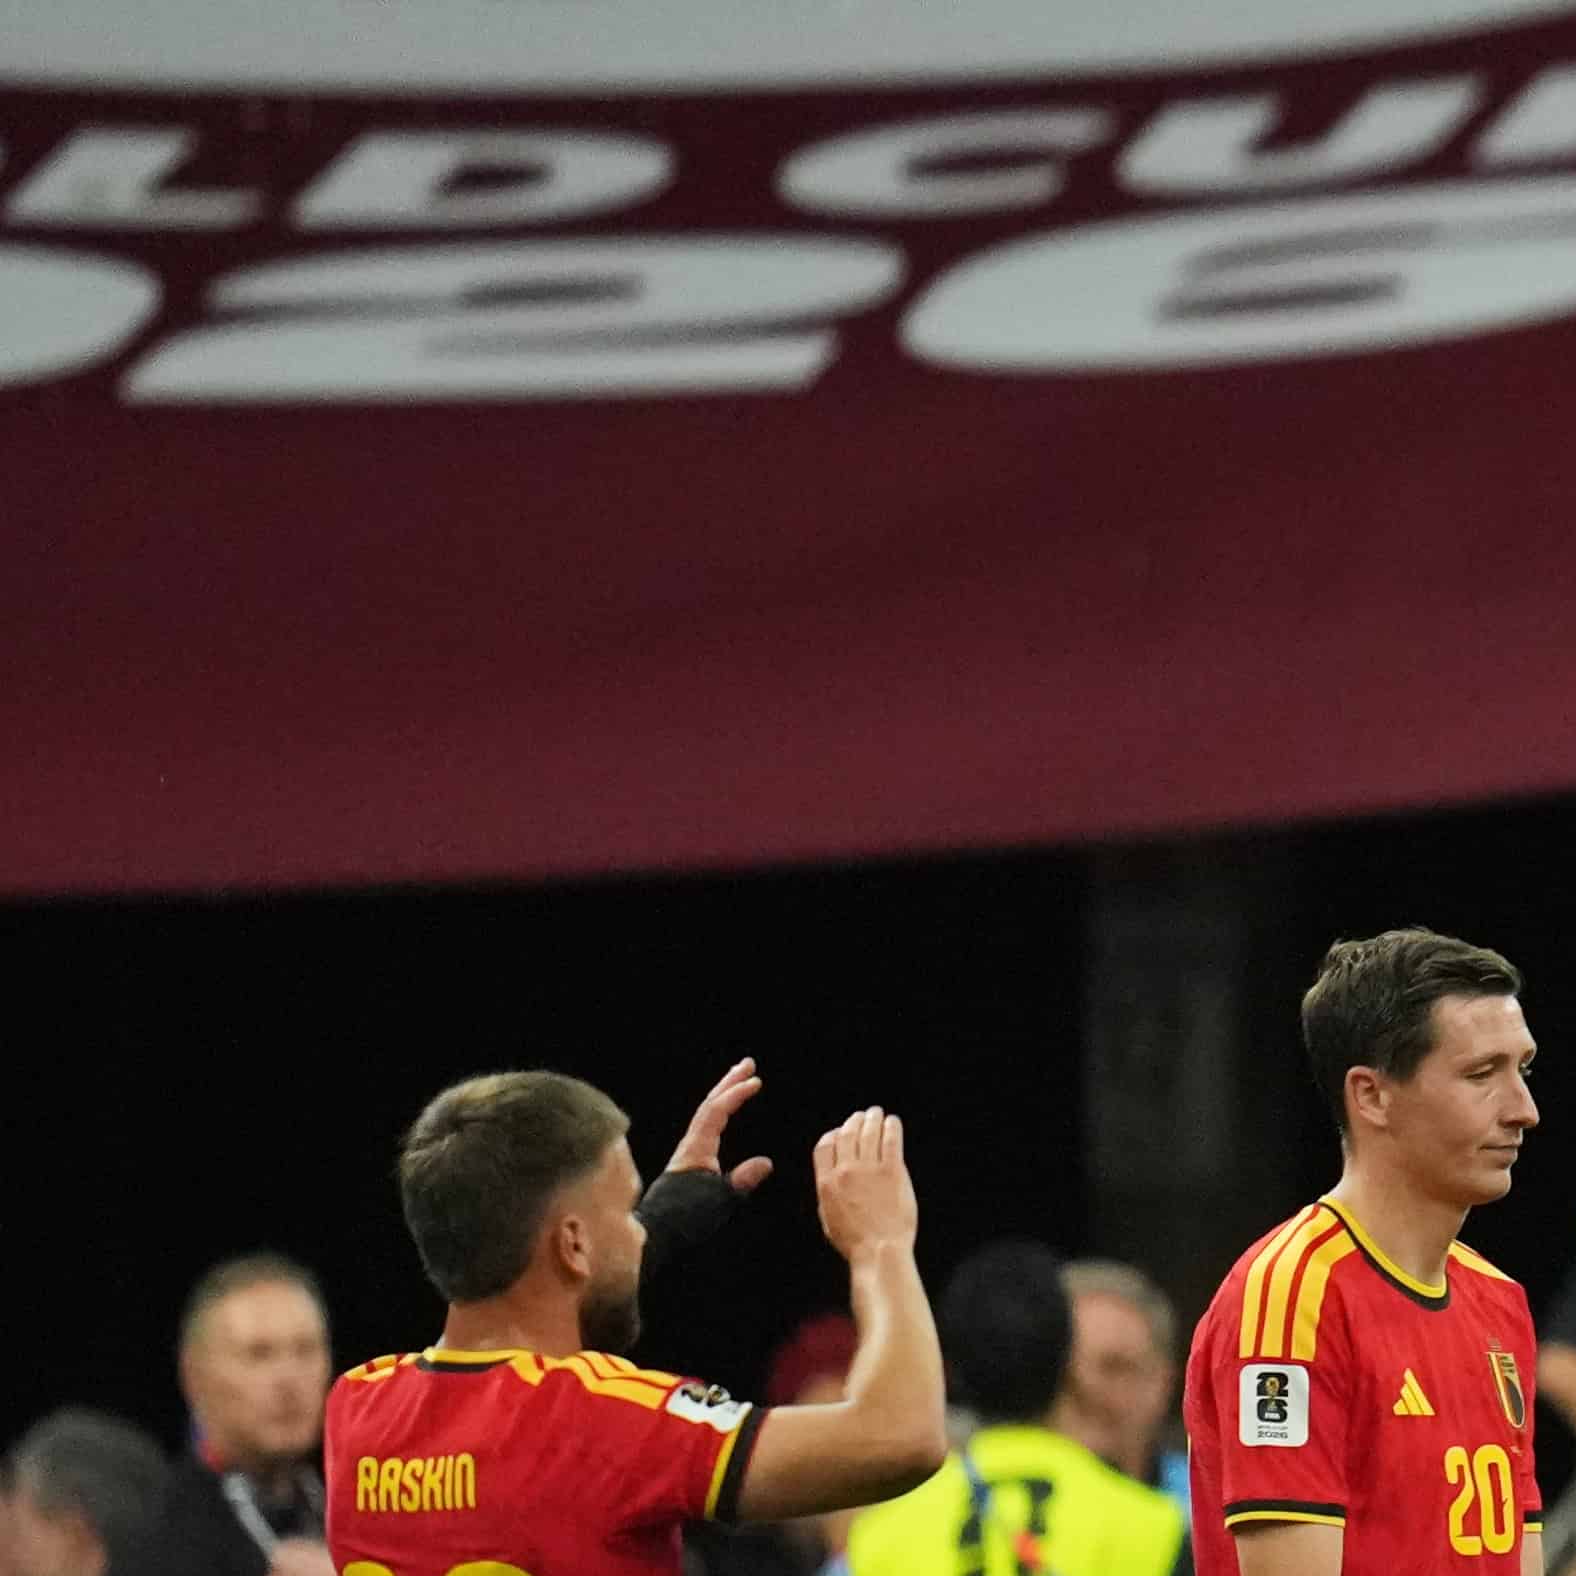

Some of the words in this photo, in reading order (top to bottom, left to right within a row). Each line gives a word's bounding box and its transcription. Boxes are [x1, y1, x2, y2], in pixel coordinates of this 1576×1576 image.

[0, 128, 674, 229] LD
[356, 1453, 476, 1512] RASKIN
[1443, 1443, 1515, 1556] 20
